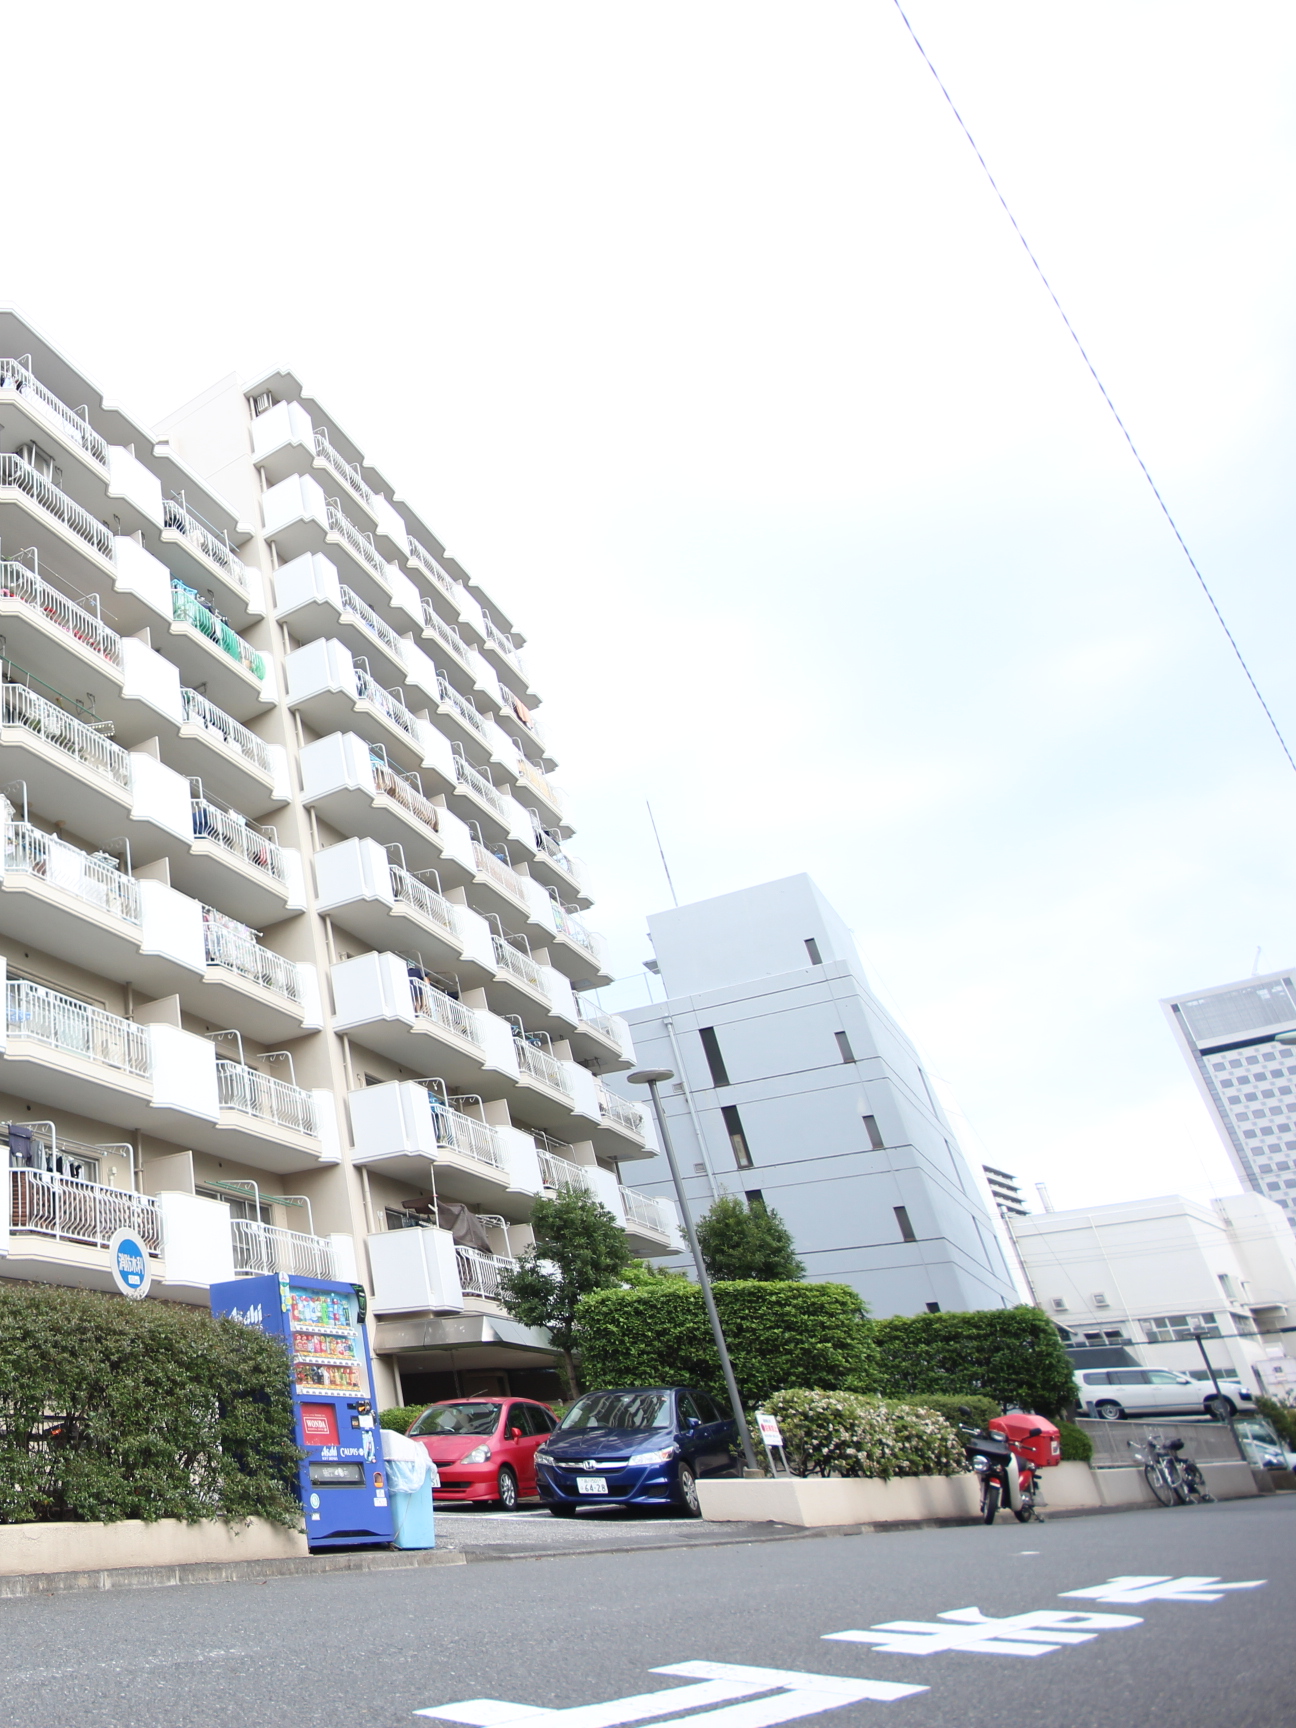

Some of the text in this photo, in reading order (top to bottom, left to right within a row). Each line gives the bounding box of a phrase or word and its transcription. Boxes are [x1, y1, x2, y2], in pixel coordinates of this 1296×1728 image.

[118, 1252, 144, 1275] 消防水利
[305, 1419, 327, 1429] WONDA
[321, 1444, 360, 1457] Asahi CALPIS
[584, 1483, 607, 1493] 64-28
